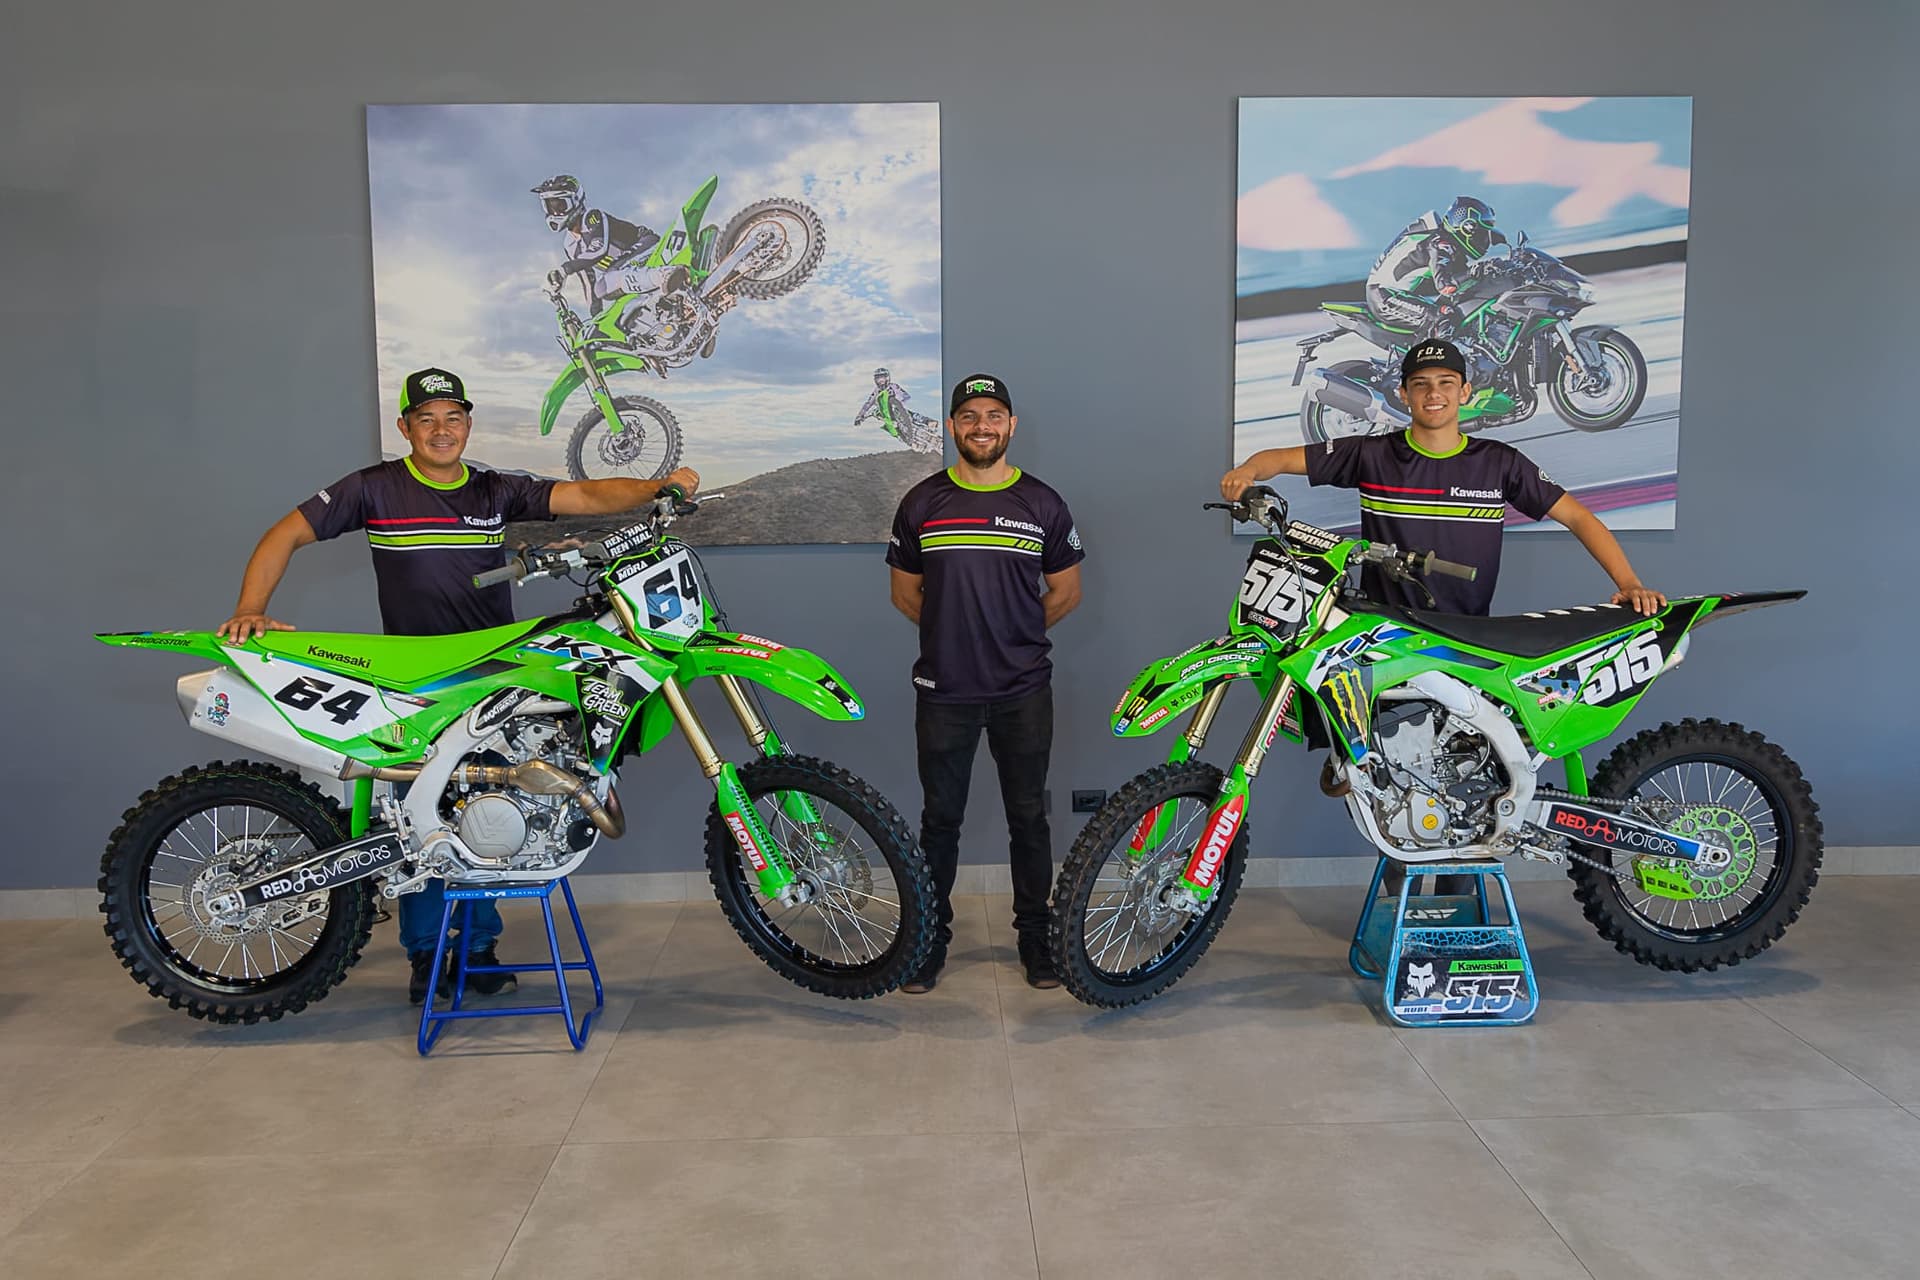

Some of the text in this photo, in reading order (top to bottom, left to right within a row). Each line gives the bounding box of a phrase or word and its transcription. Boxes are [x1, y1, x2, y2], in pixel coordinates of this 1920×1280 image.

[1417, 346, 1444, 358] FOX
[1286, 528, 1337, 551] RENTHAL
[1291, 521, 1341, 543] RENTHAL
[643, 558, 700, 630] 64
[1238, 559, 1326, 624] 515
[308, 645, 371, 669] Kawasaki
[1180, 653, 1260, 679] PRO CIRCUIT
[1576, 630, 1664, 706] 515
[273, 676, 372, 726] 64
[582, 677, 623, 701] TEAM
[583, 692, 629, 718] GREEN
[1181, 688, 1200, 703] FOX
[1141, 709, 1168, 730] MOTUL
[734, 783, 784, 870] BRIDGESTONE
[1555, 811, 1678, 855] RED MOTORS
[727, 816, 765, 870] MOTUL
[1194, 809, 1239, 885] MOTUL
[260, 844, 392, 899] RED MOTORS
[1457, 960, 1508, 972] Kawasaki
[1443, 975, 1520, 1013] 515
